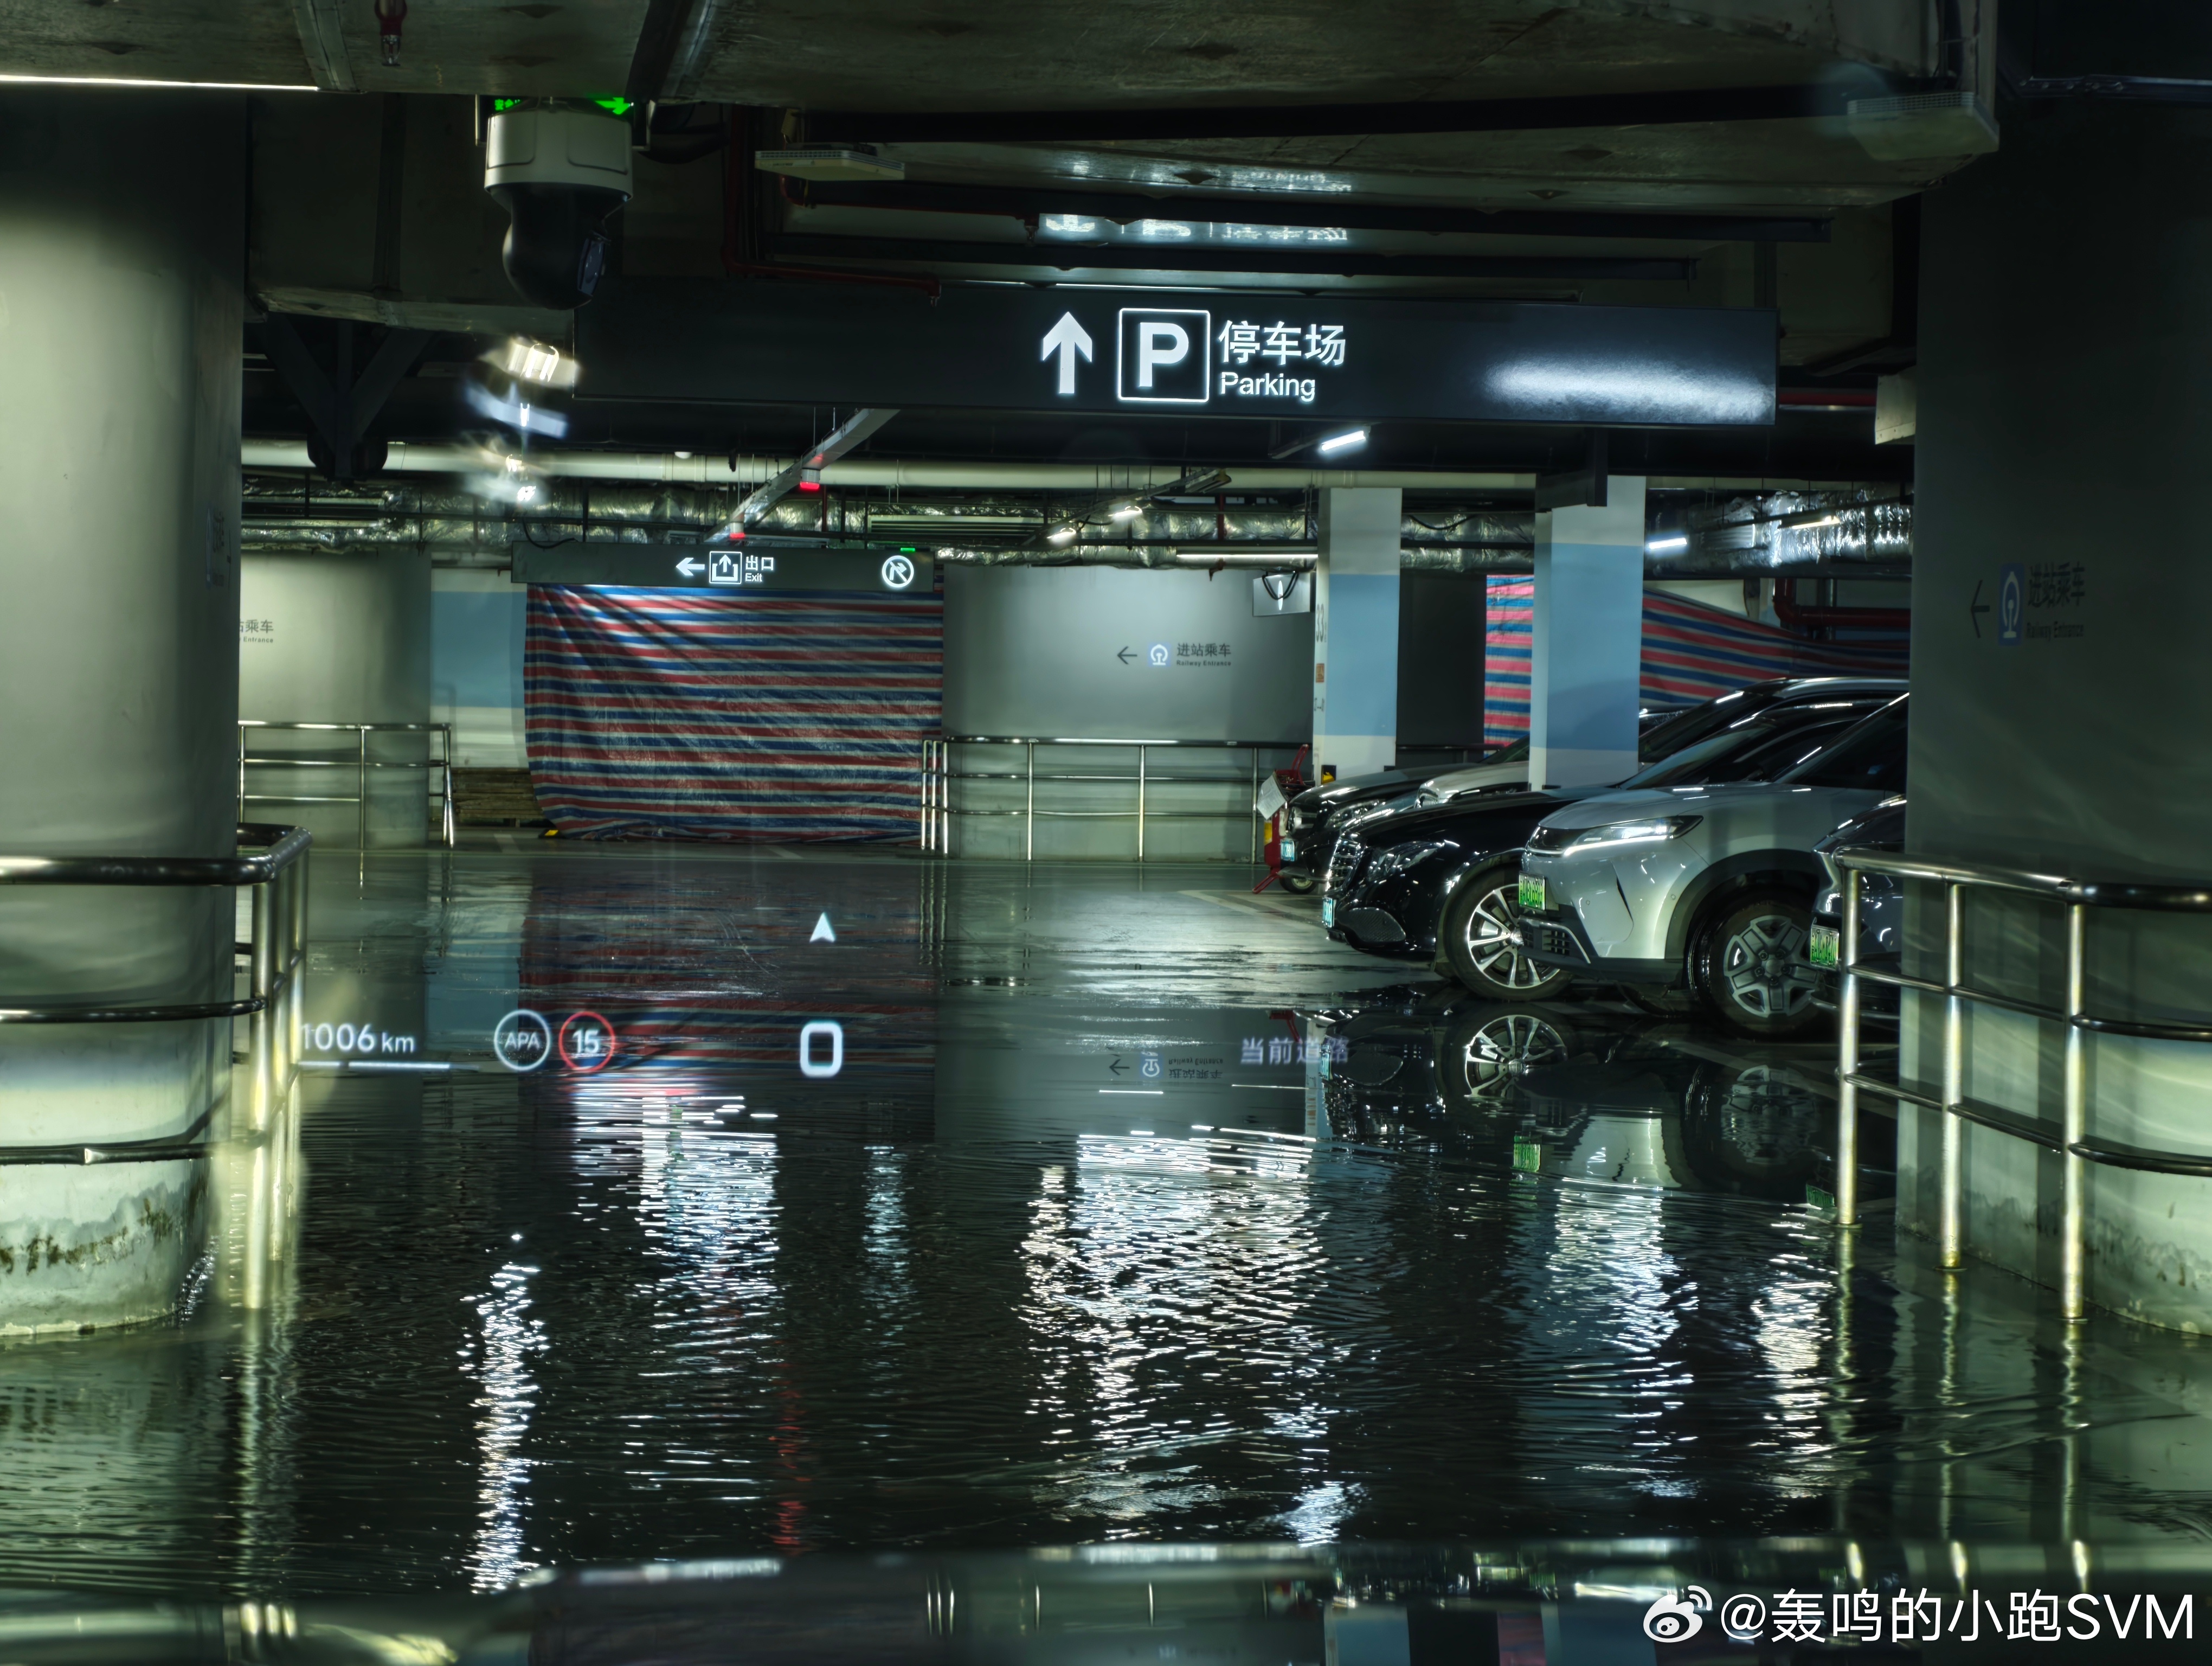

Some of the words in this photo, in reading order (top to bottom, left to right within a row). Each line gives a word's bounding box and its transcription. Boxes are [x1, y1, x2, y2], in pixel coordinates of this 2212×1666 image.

[1139, 322, 1189, 388] P
[1218, 320, 1346, 366] 停车场
[1220, 371, 1316, 402] Parking
[745, 555, 774, 572] 出口
[745, 573, 763, 582] Exit
[2028, 561, 2085, 608] 进站乘车
[1176, 643, 1232, 657] 进站乘车
[303, 1023, 376, 1052] 1006
[382, 1032, 415, 1053] km
[504, 1033, 540, 1049] APA
[572, 1029, 600, 1053] 15
[800, 1020, 843, 1078] 0
